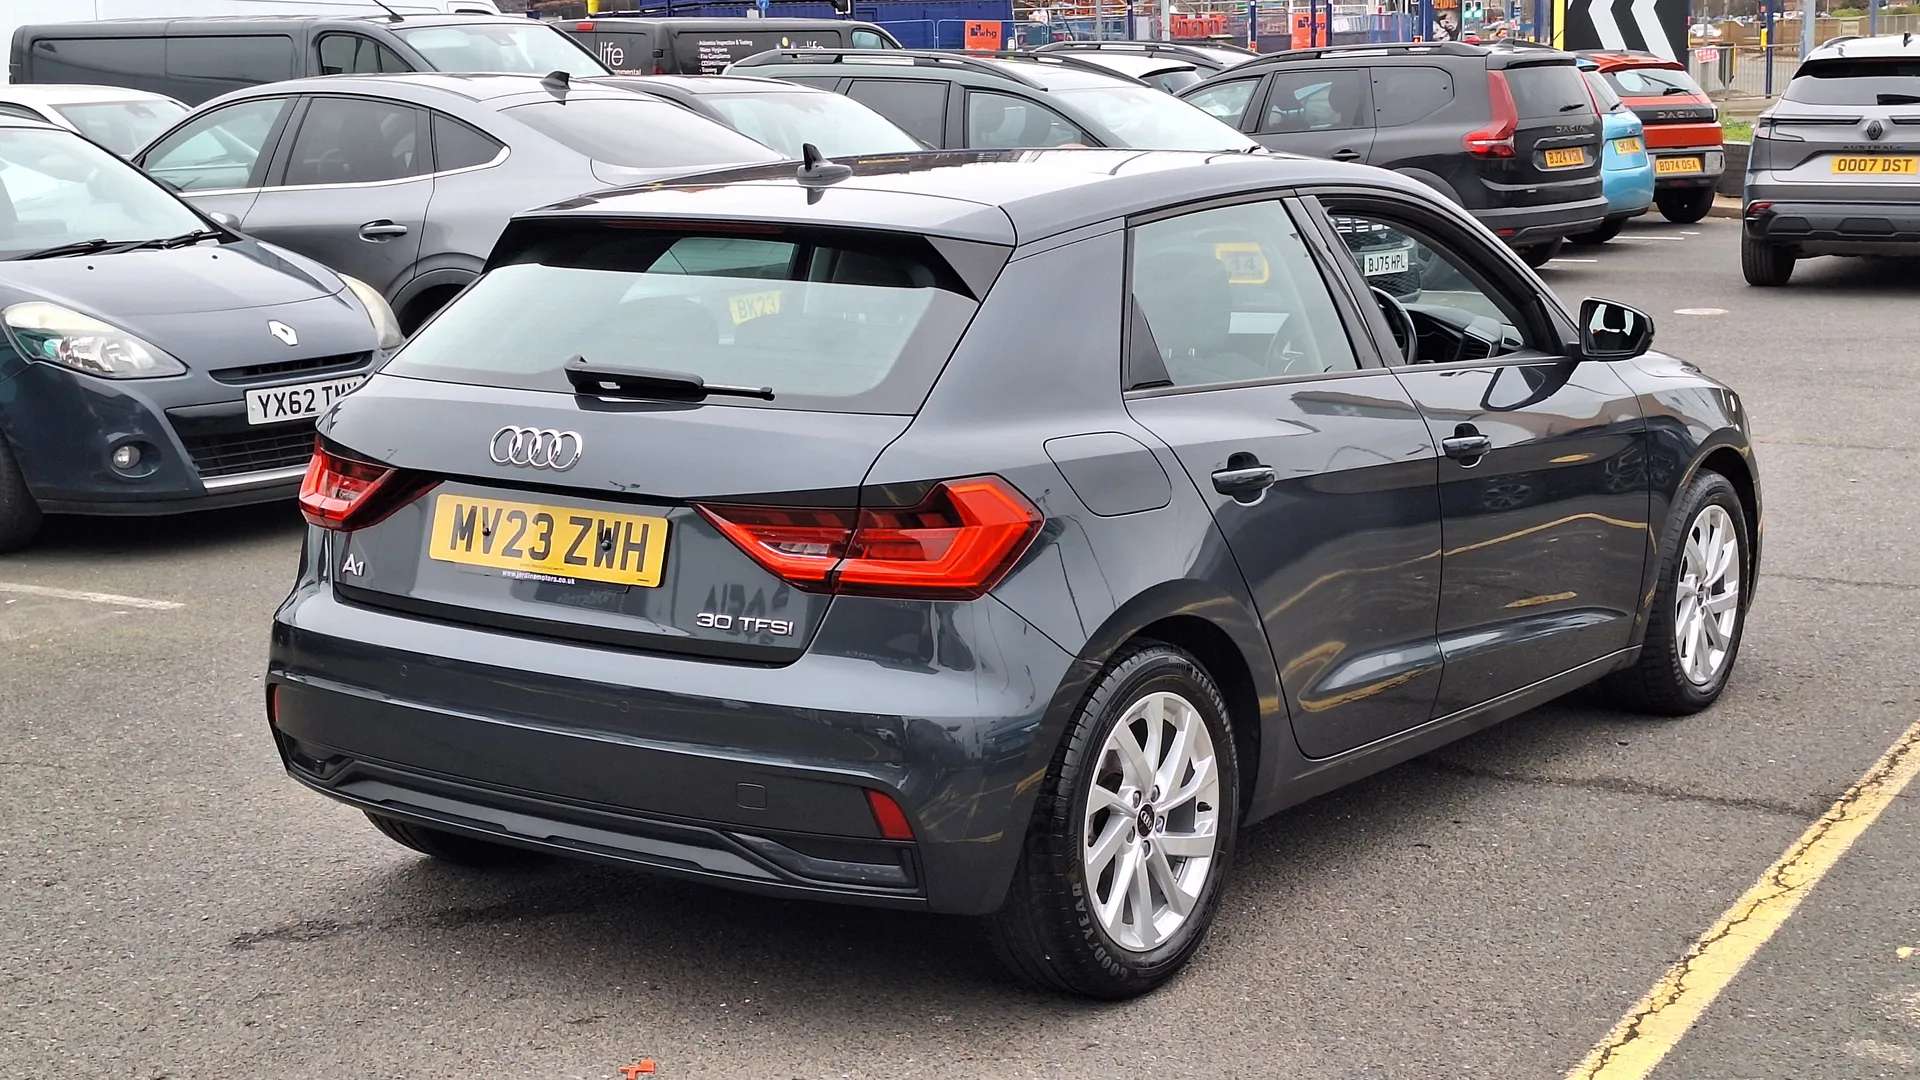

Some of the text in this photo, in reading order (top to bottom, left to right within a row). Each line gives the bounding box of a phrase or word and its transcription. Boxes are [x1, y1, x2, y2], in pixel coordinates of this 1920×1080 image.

[600, 42, 624, 66] life
[1656, 110, 1699, 119] DACIA
[1555, 125, 1585, 133] DACIA
[1881, 158, 1912, 172] DST
[1368, 253, 1406, 272] BJ75 HPL
[257, 382, 357, 418] YX62 TM
[450, 503, 650, 573] MV23 ZWH
[342, 553, 365, 576] A1
[696, 612, 794, 636] 30 TFSI
